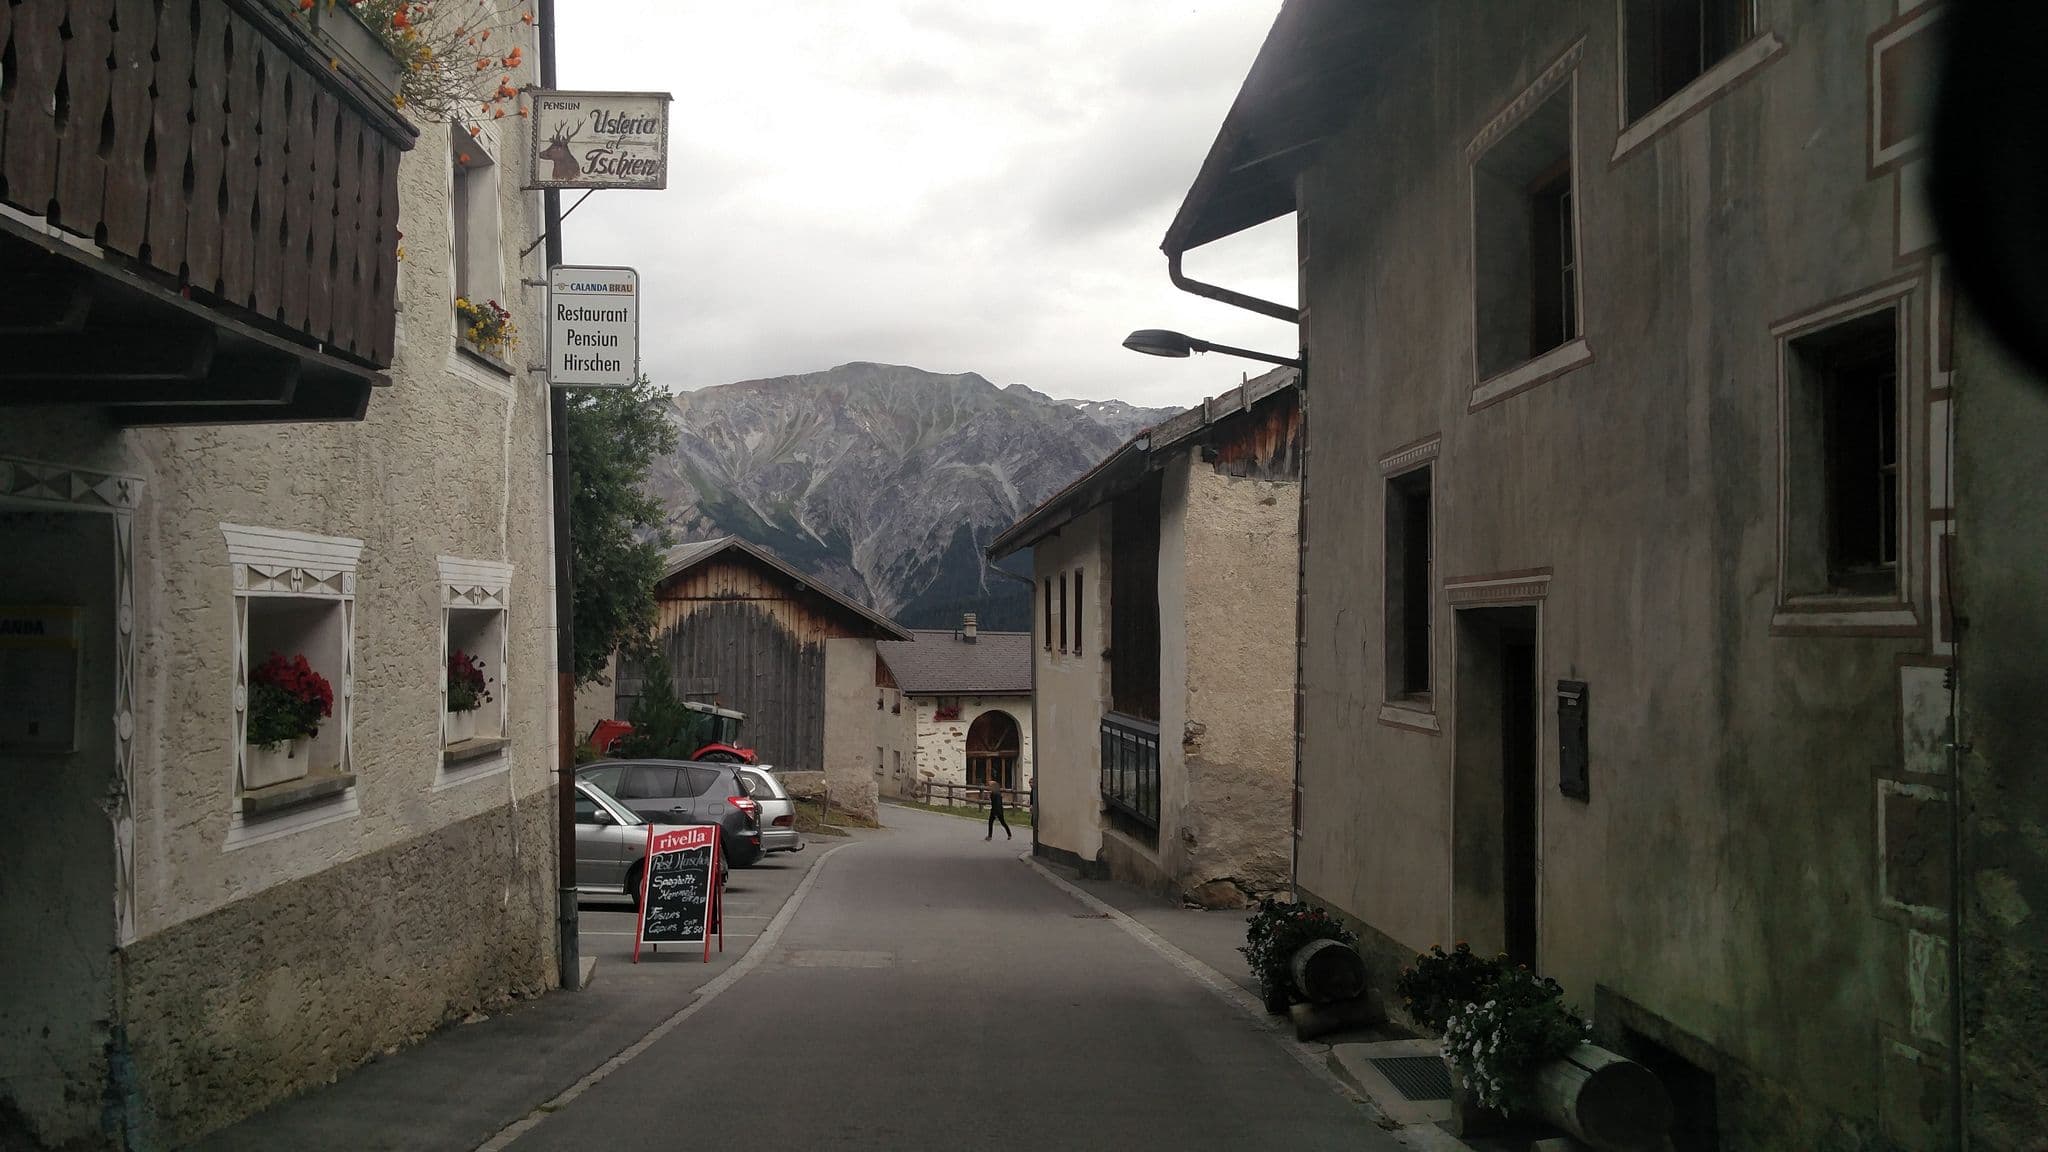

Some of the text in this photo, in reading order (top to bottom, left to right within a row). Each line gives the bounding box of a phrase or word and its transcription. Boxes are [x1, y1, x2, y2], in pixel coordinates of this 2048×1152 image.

[543, 102, 580, 110] PENSIUN
[590, 109, 657, 135] Usteria
[570, 283, 608, 292] CALANDA
[557, 303, 628, 322] Restaurant
[567, 328, 618, 347] Pensiun
[564, 352, 620, 372] Hirschen
[660, 830, 705, 849] rivella
